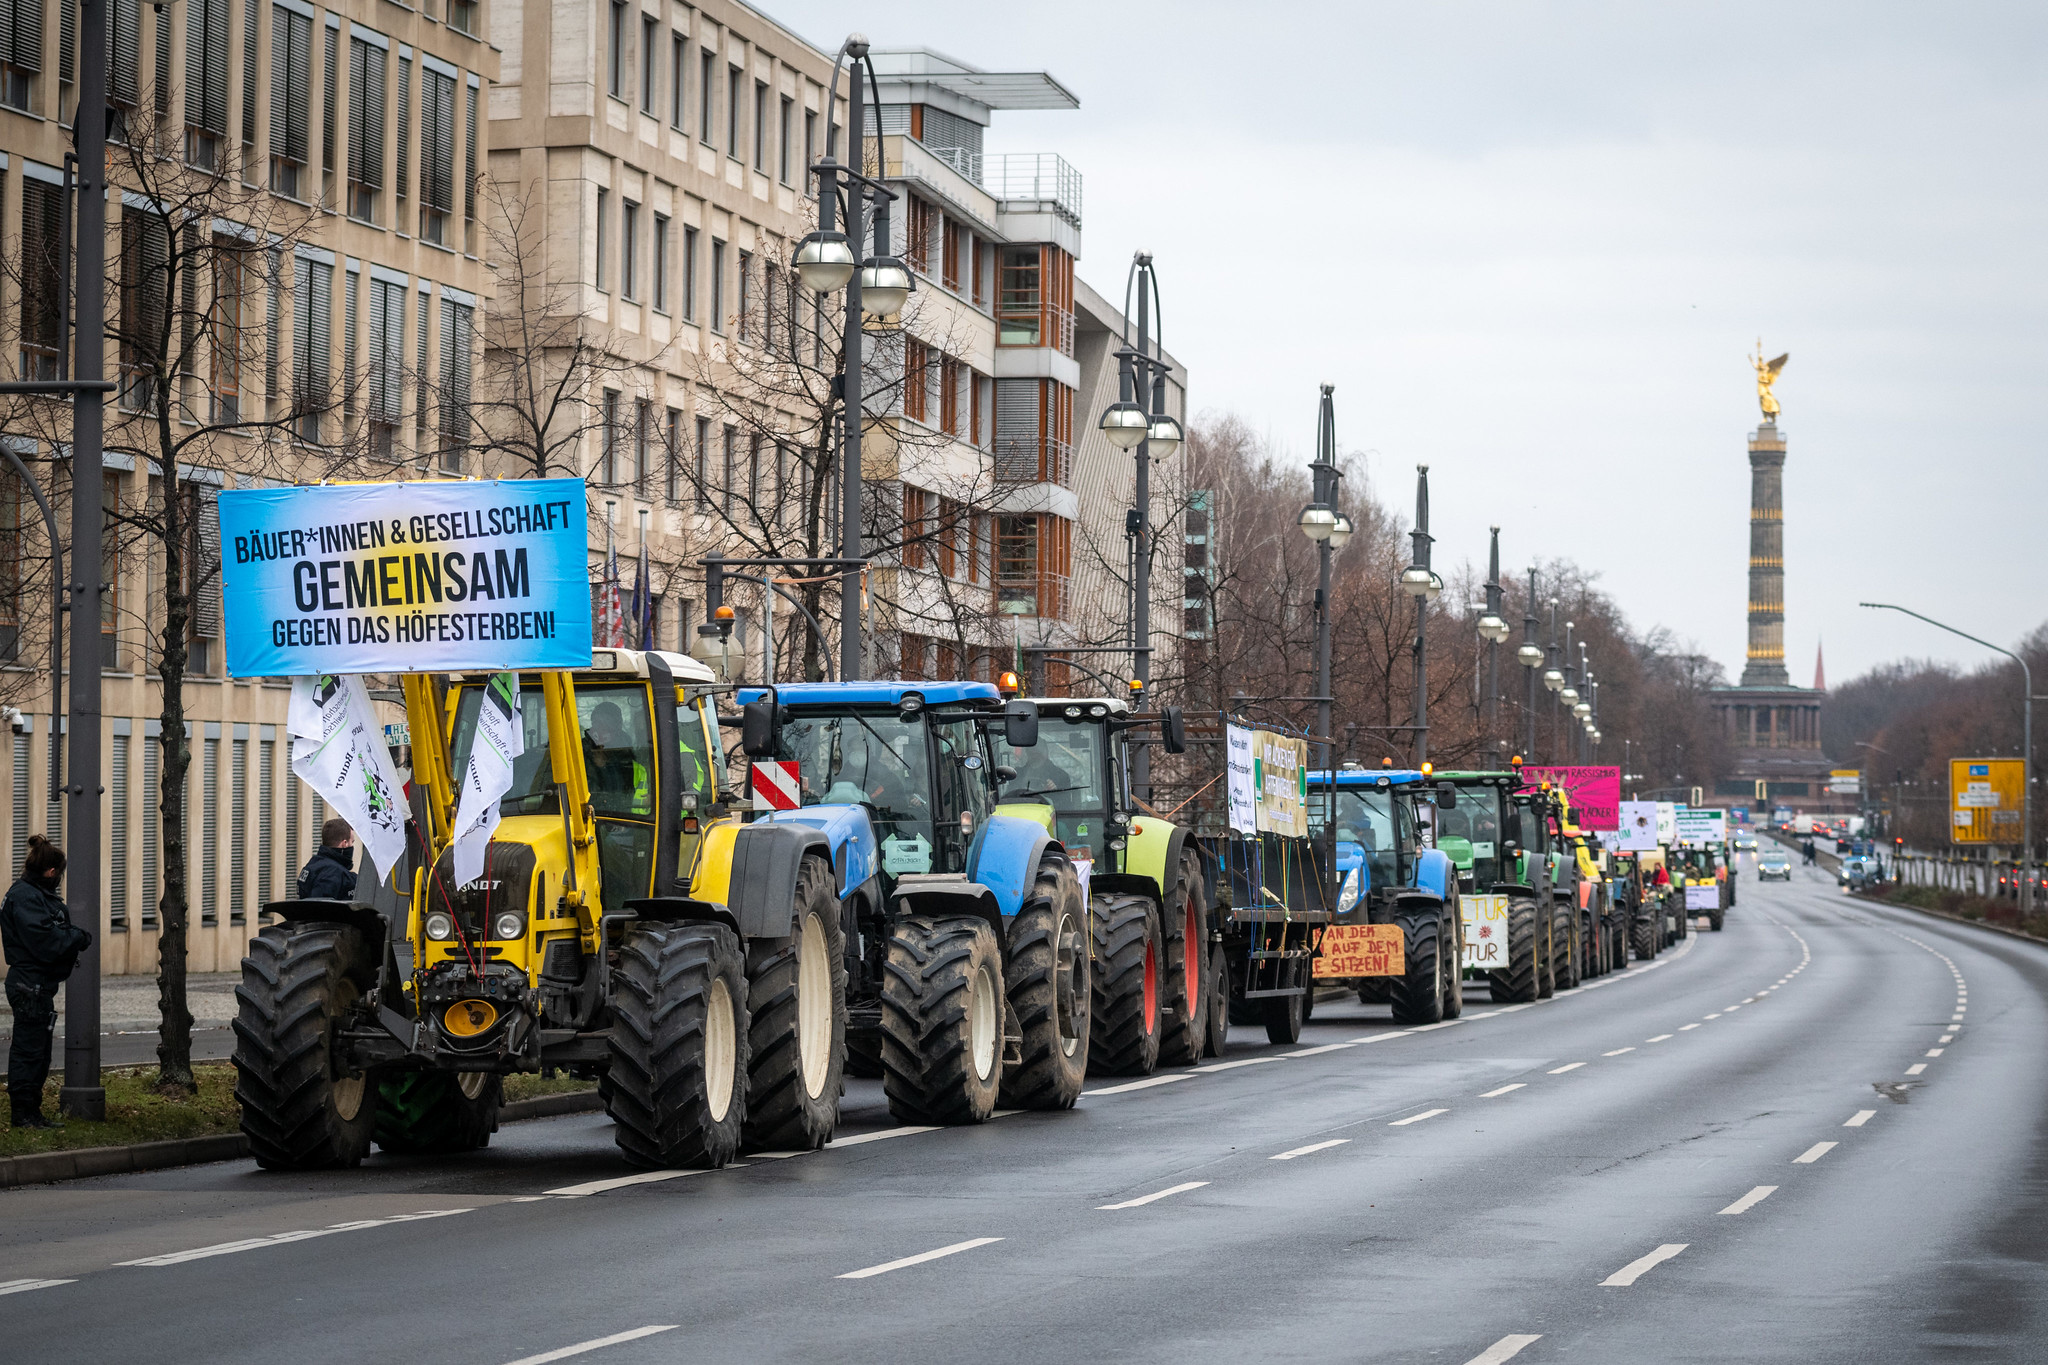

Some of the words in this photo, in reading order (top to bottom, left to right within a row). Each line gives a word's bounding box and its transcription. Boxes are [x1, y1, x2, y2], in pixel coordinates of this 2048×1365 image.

[391, 519, 406, 545] &
[410, 501, 572, 544] GESELLSCHAFT
[293, 547, 530, 613] GEMEINSAM
[272, 617, 341, 648] GEGEN
[347, 615, 390, 644] DAS
[395, 609, 556, 643] HÖFESTERBEN!
[1571, 768, 1616, 778] RASSISMUS
[461, 880, 502, 891] NDT
[1327, 927, 1344, 941] AN
[1349, 926, 1375, 939] DEM
[1332, 942, 1360, 955] AUF
[1367, 940, 1399, 954] DEM
[1331, 954, 1389, 975] SITZEN!
